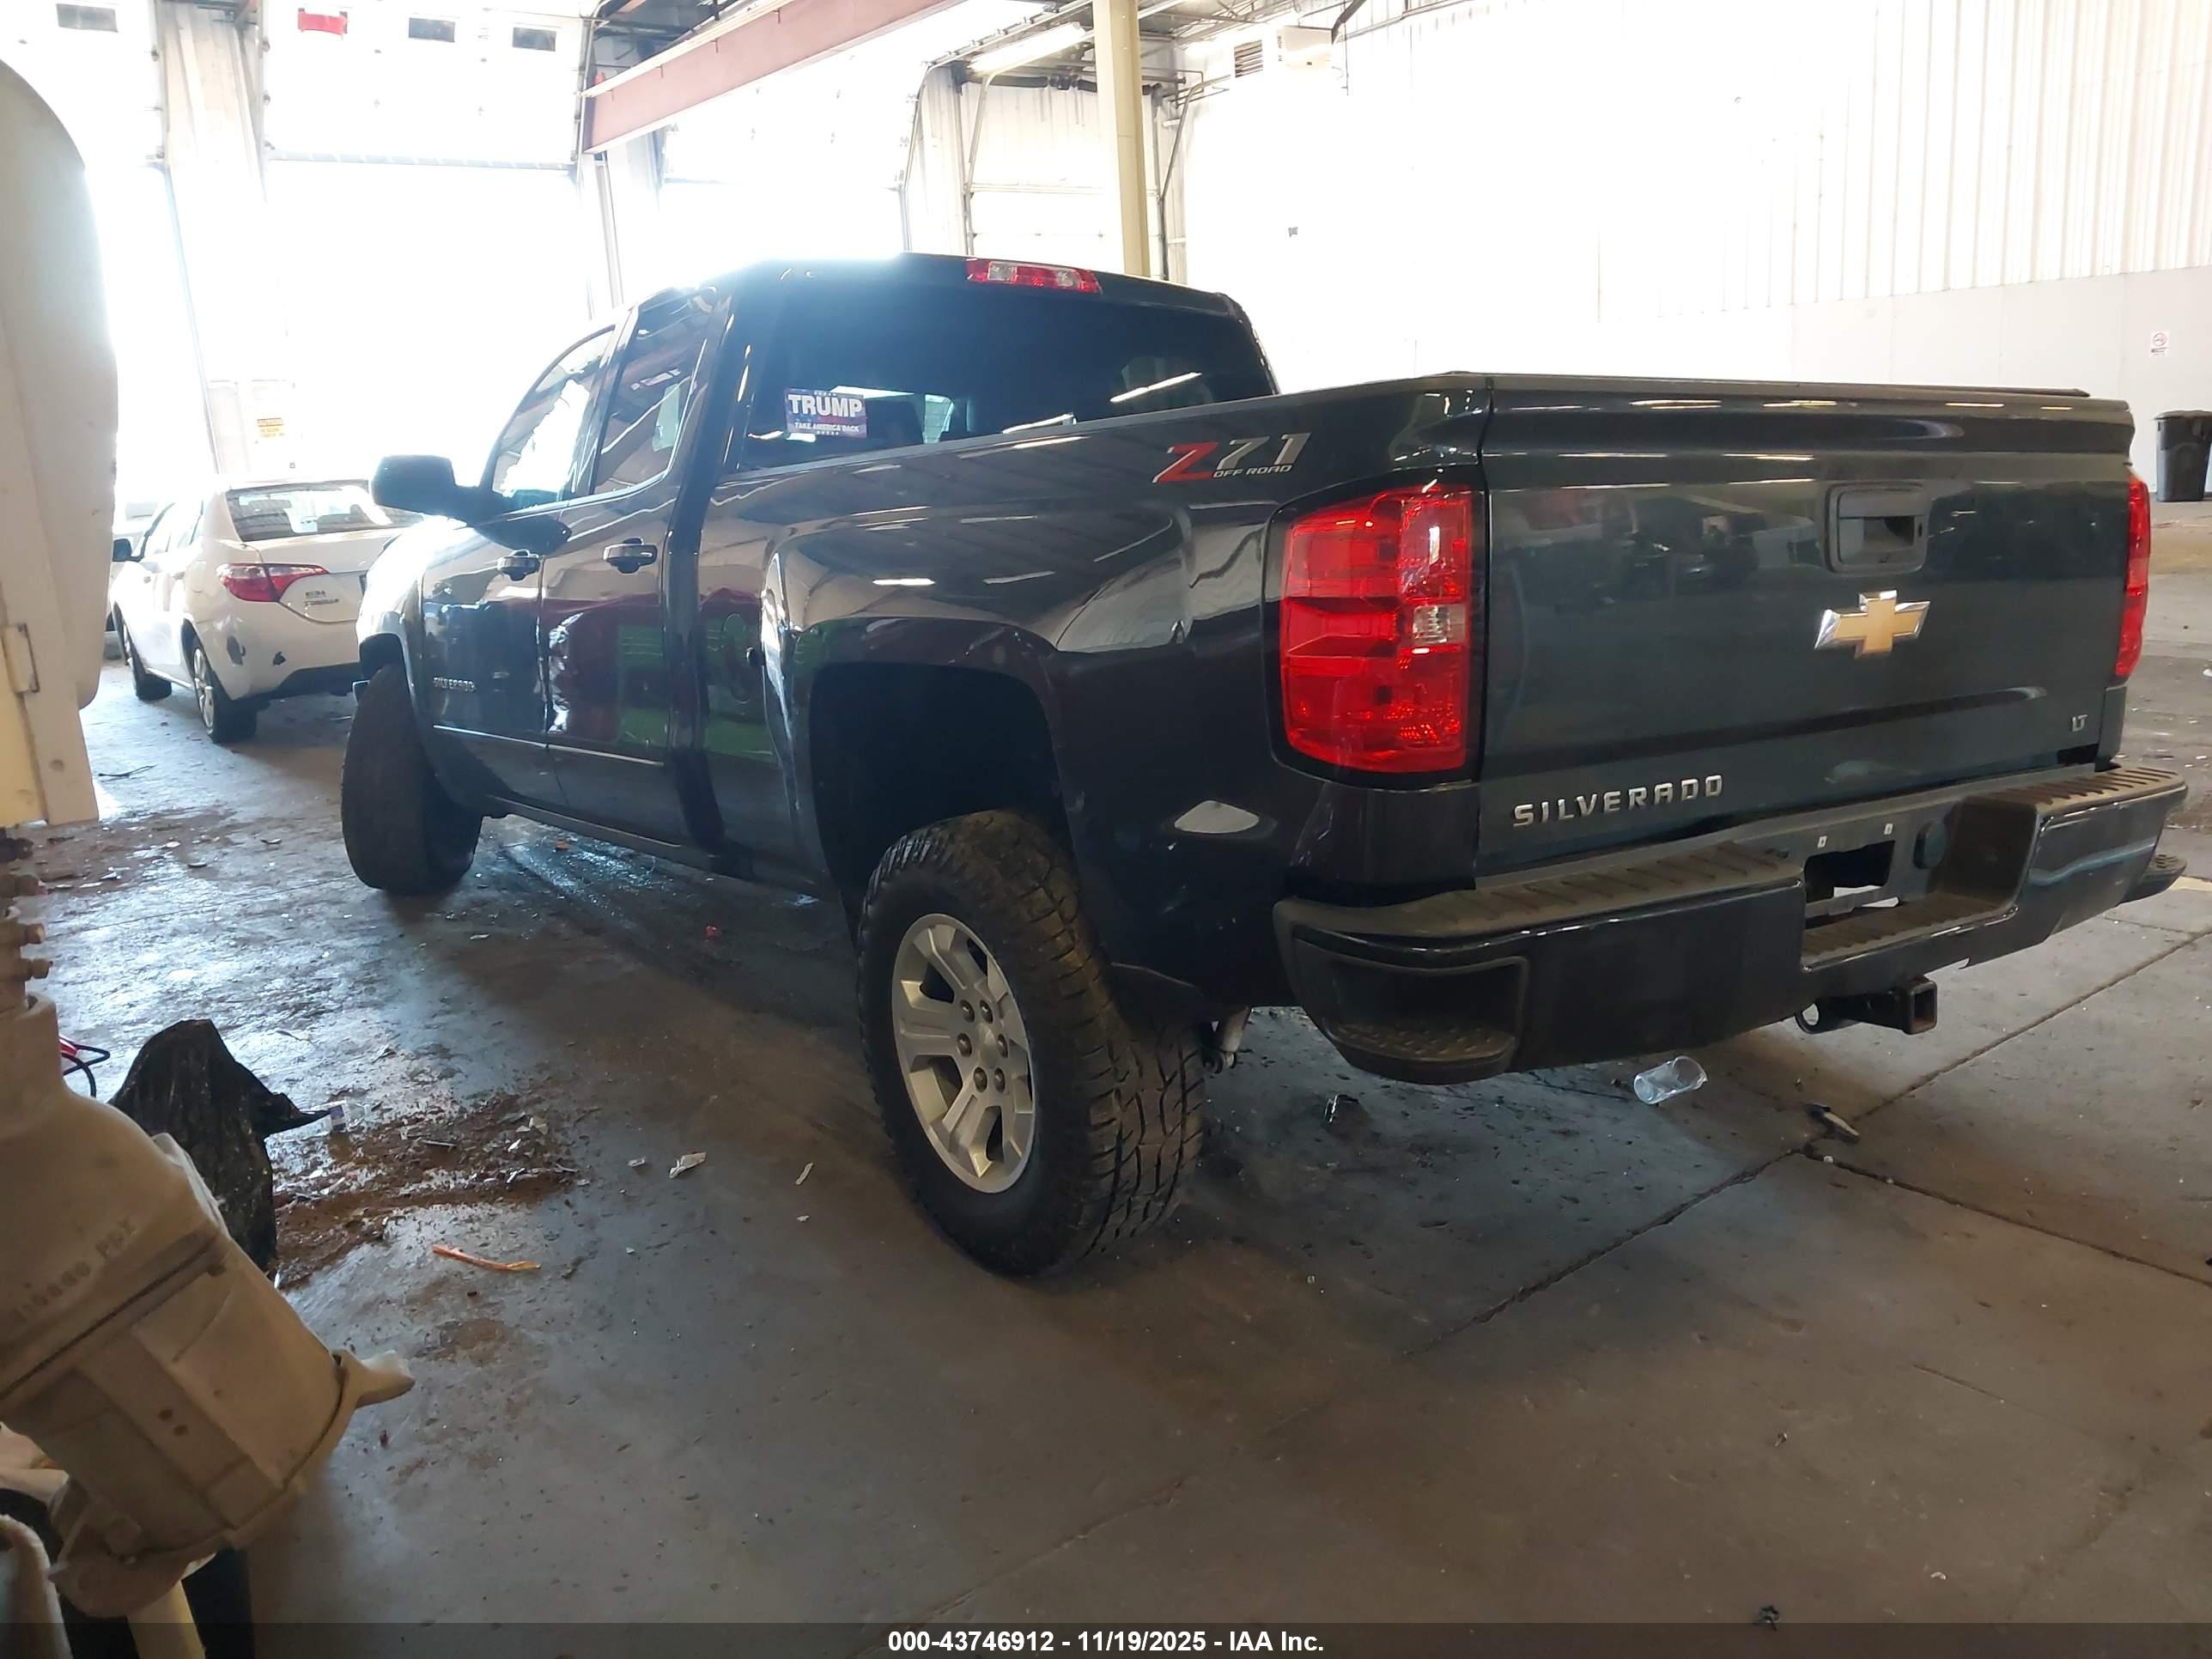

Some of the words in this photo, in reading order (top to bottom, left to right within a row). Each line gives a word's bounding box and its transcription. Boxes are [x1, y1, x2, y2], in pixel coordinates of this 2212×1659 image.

[787, 394, 862, 418] TRUMP
[812, 423, 841, 432] AMERICA
[1152, 432, 1311, 484] Z71
[1212, 468, 1244, 479] OFF
[1246, 465, 1292, 476] ROAD
[2072, 714, 2088, 732] LT
[1512, 774, 1723, 828] SILVERADO
